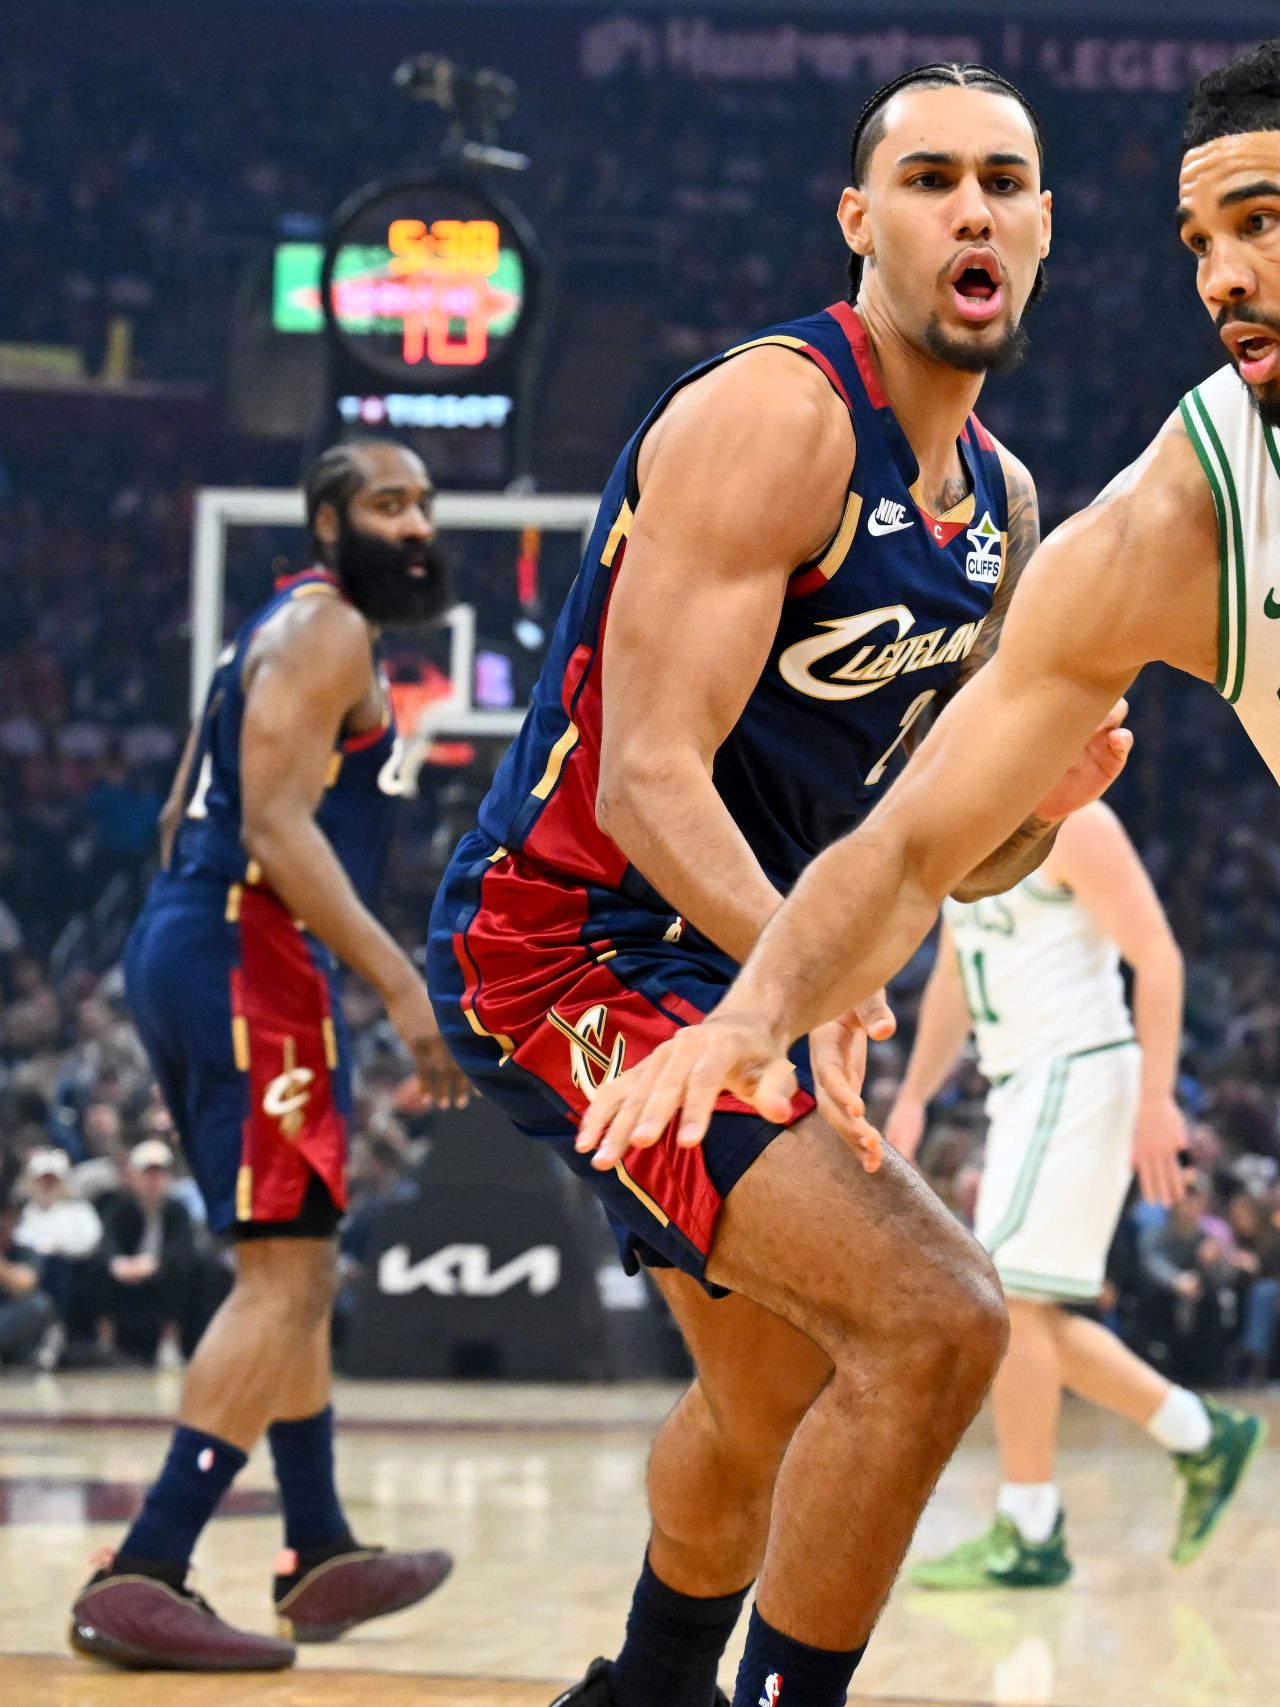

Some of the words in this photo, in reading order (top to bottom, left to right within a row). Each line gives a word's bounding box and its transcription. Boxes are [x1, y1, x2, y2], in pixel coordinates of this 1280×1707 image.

[876, 497, 907, 526] NIKE
[968, 558, 1000, 577] CLIFFS
[779, 604, 987, 701] CLEVELAN
